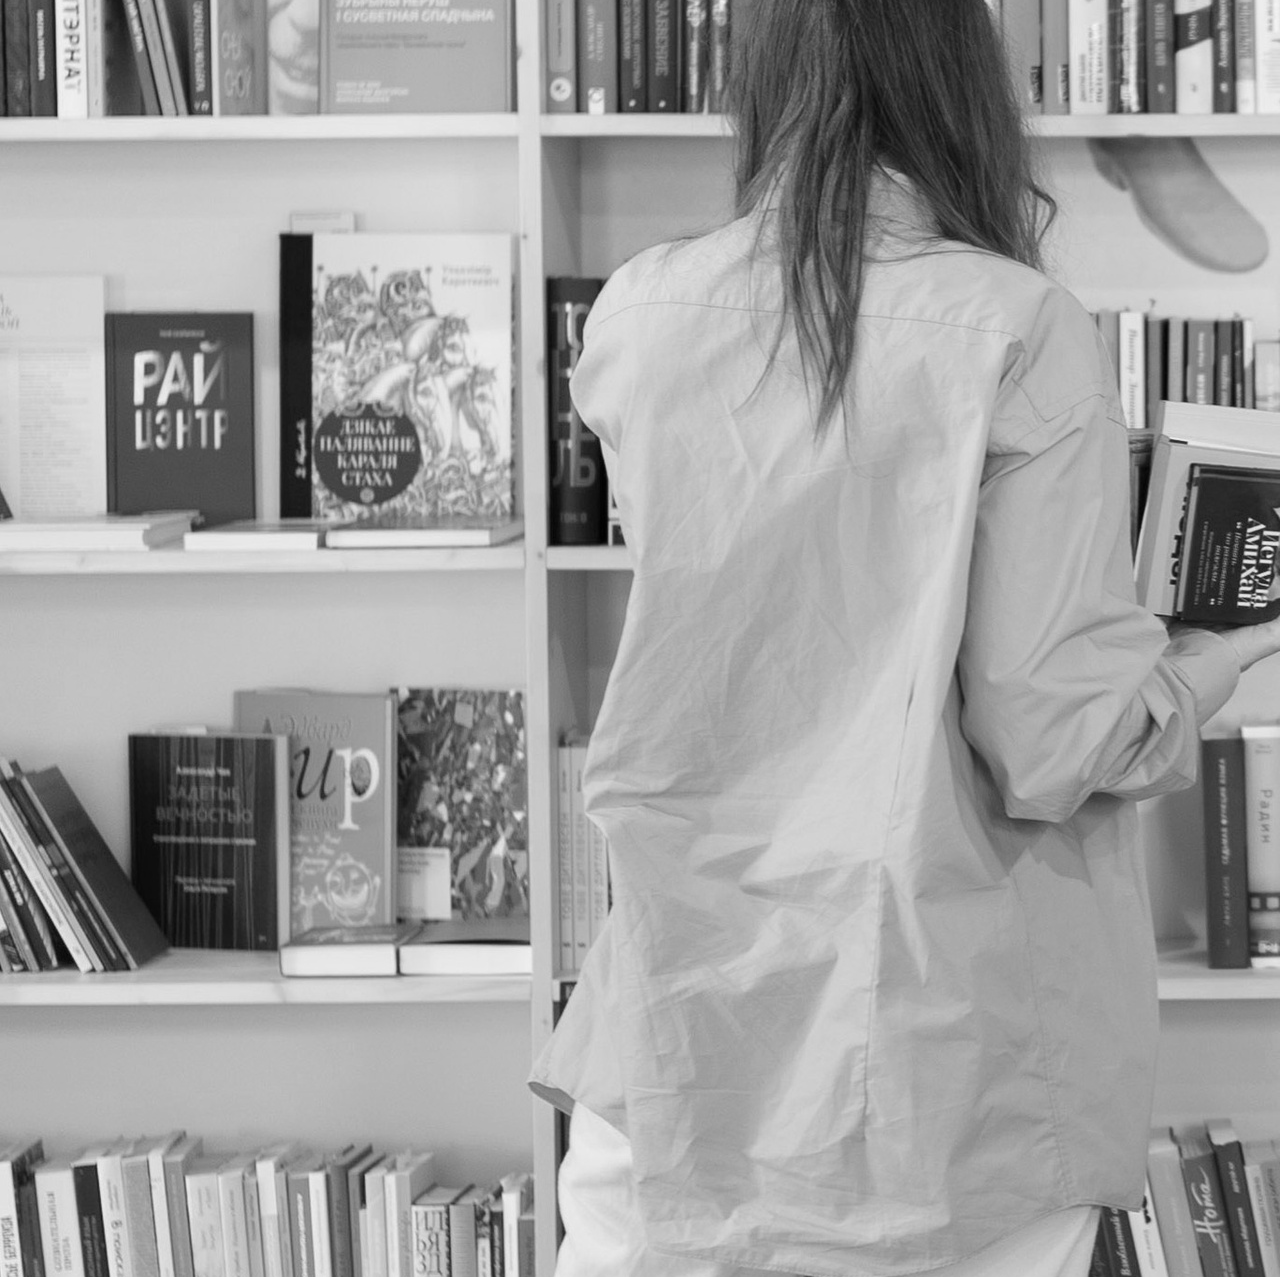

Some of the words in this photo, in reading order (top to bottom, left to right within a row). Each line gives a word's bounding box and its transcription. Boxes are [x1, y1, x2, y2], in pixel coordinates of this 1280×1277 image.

[133, 339, 230, 406] РАЙ
[135, 408, 229, 452] ЦЭНТР
[1237, 517, 1267, 608] Амихай
[1258, 789, 1273, 844] Радин
[1190, 1166, 1224, 1243] Нота
